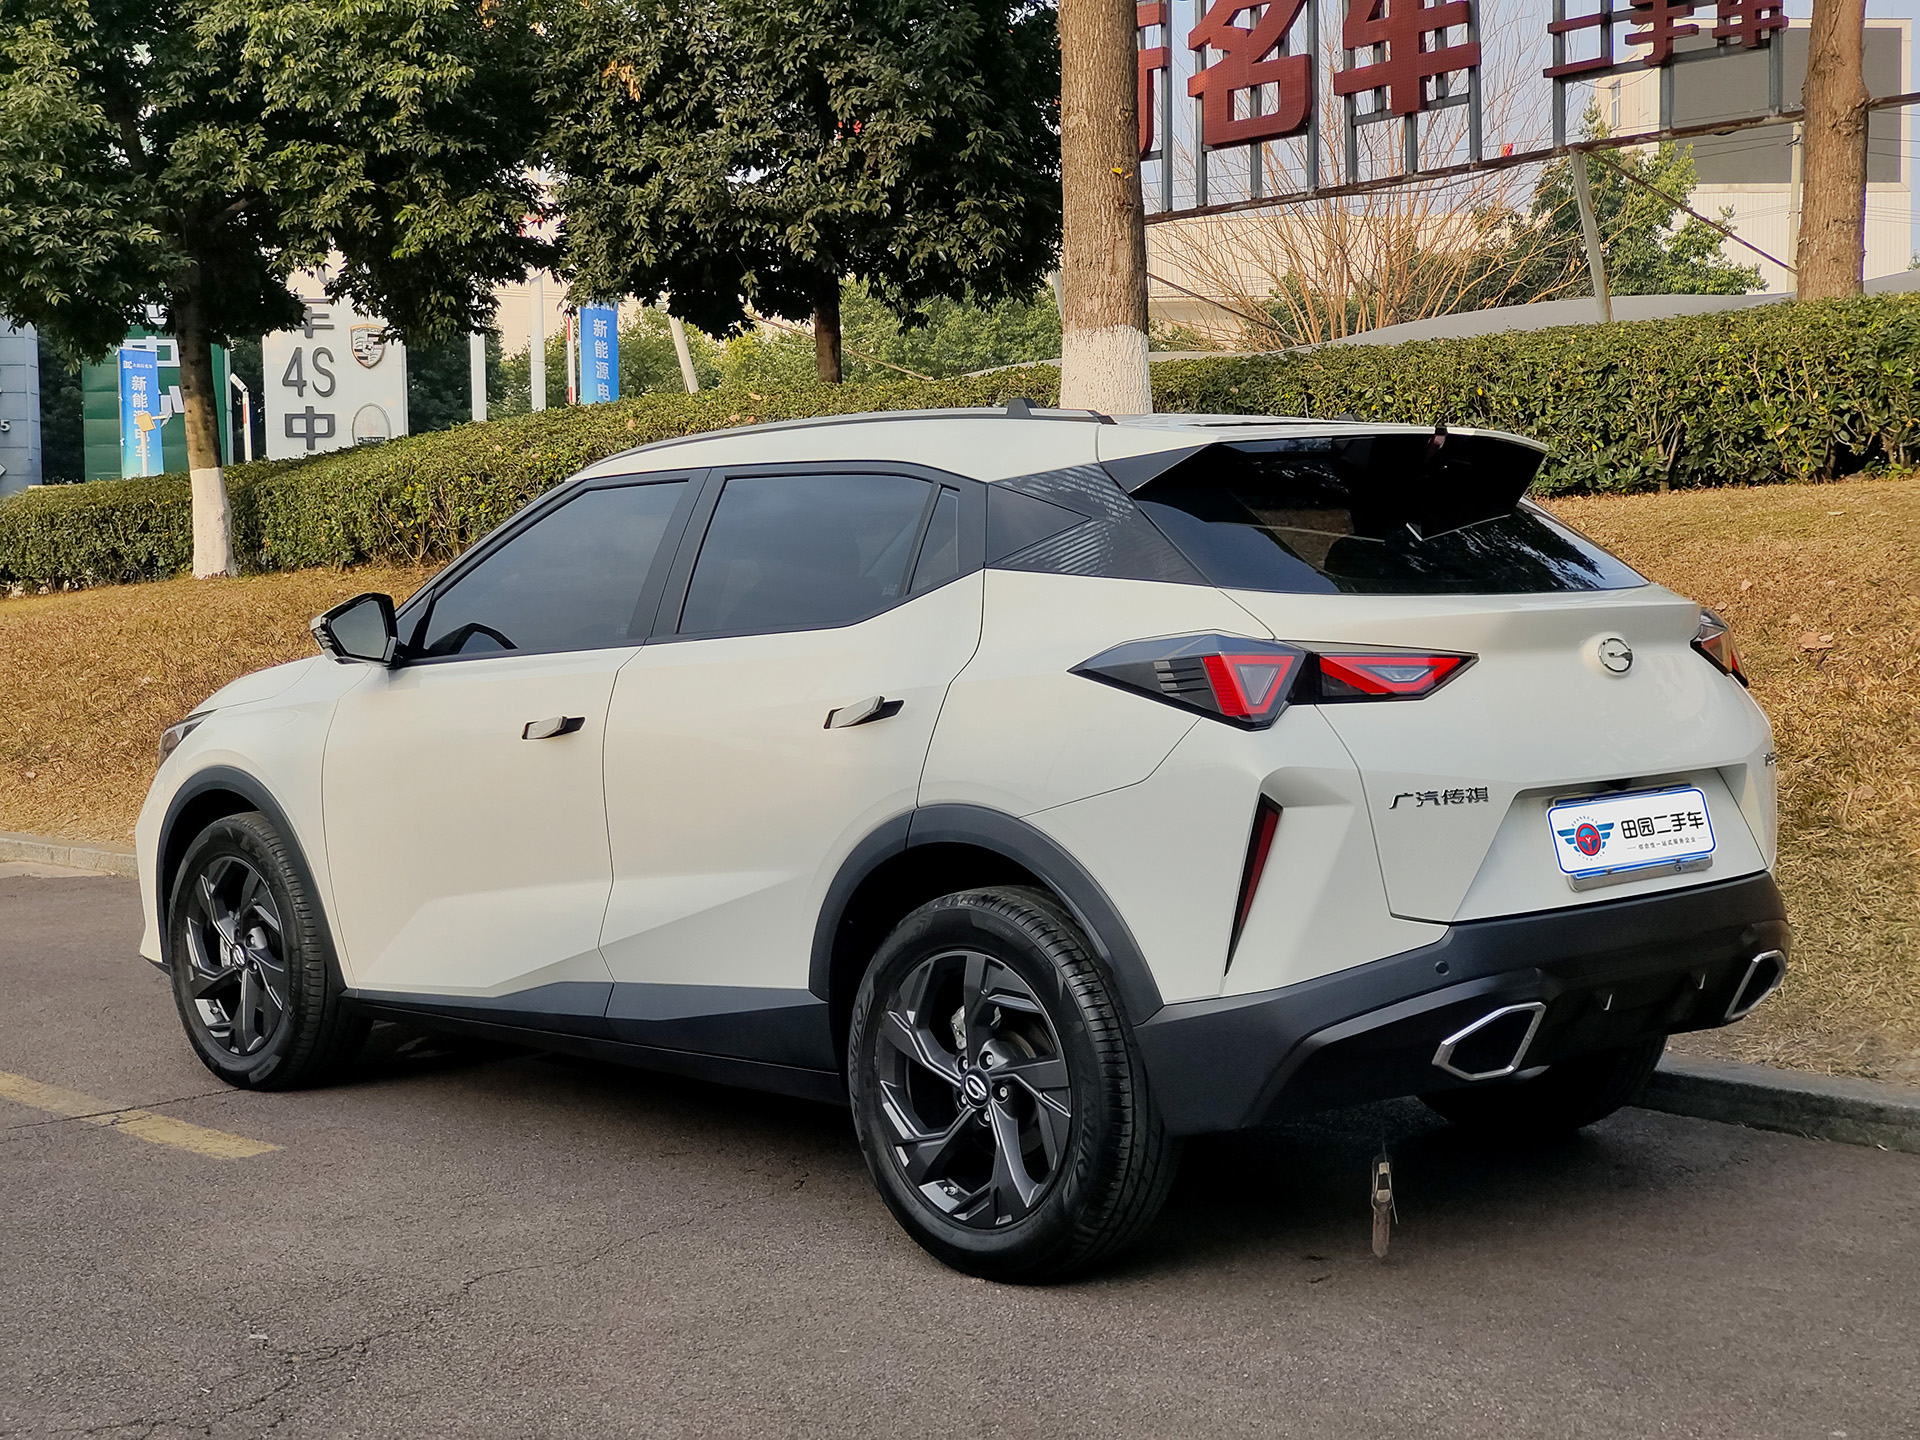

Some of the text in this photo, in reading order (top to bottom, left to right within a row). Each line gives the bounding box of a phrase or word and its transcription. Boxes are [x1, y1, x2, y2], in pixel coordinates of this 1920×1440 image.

[1389, 786, 1489, 810] 广汽传祺
[1621, 811, 1705, 840] 田园二手车
